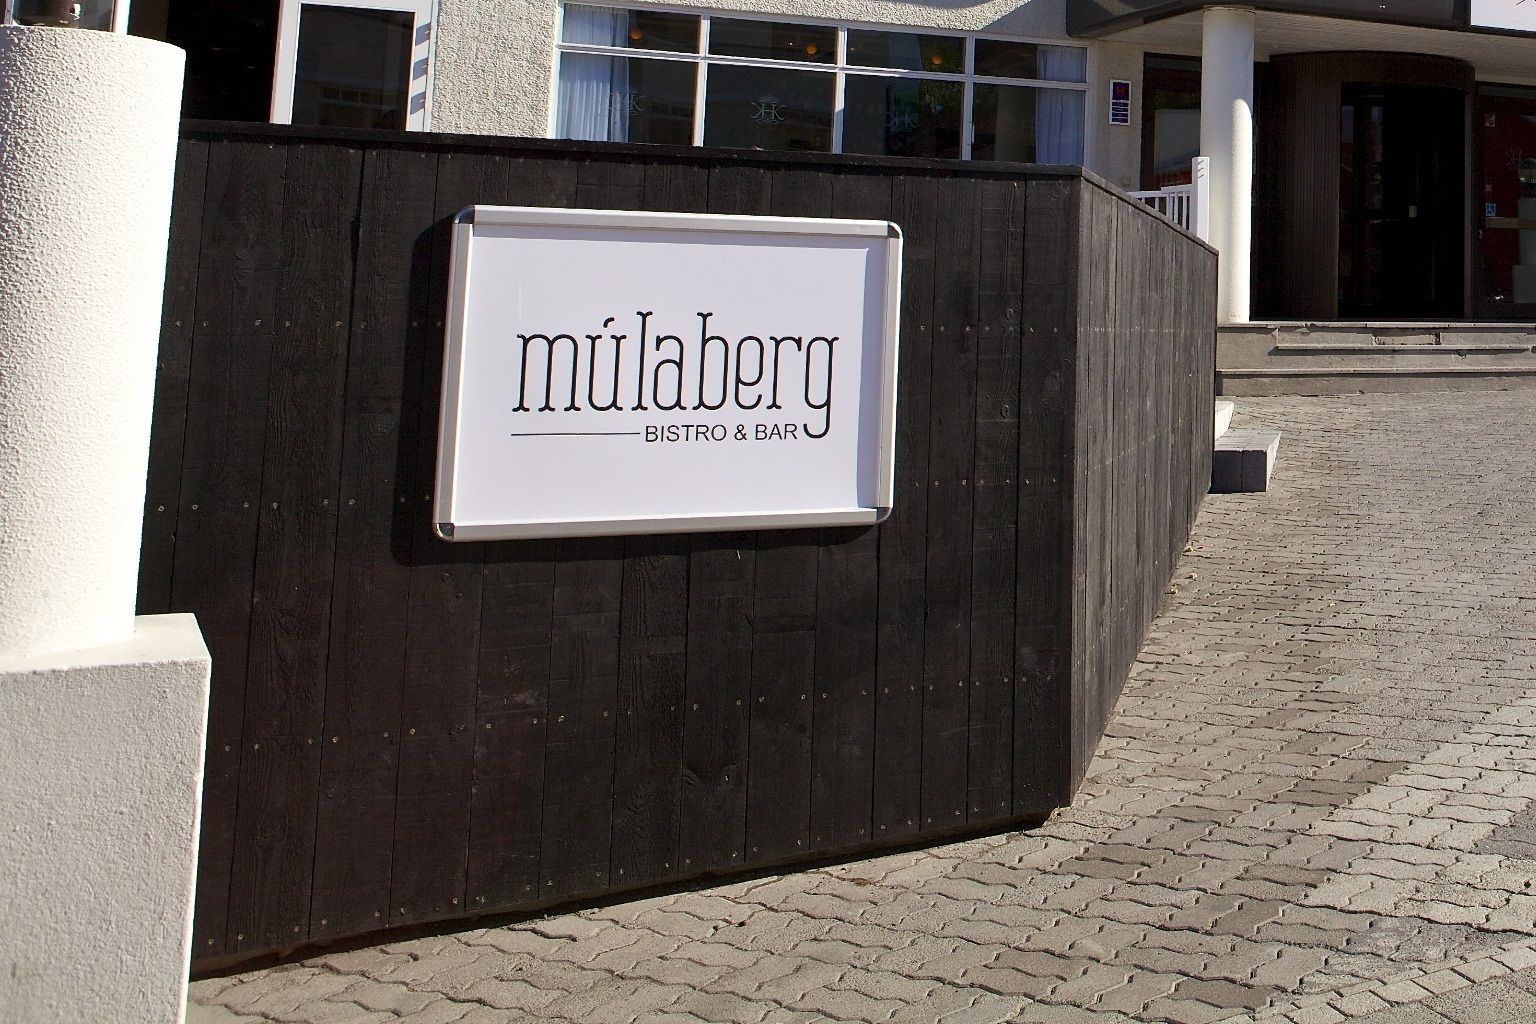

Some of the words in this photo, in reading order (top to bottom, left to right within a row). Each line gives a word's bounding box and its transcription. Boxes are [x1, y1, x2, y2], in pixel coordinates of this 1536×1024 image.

[512, 311, 839, 439] múlaberg
[644, 424, 727, 443] BISTRO
[734, 424, 748, 442] &
[754, 423, 798, 441] BAR
